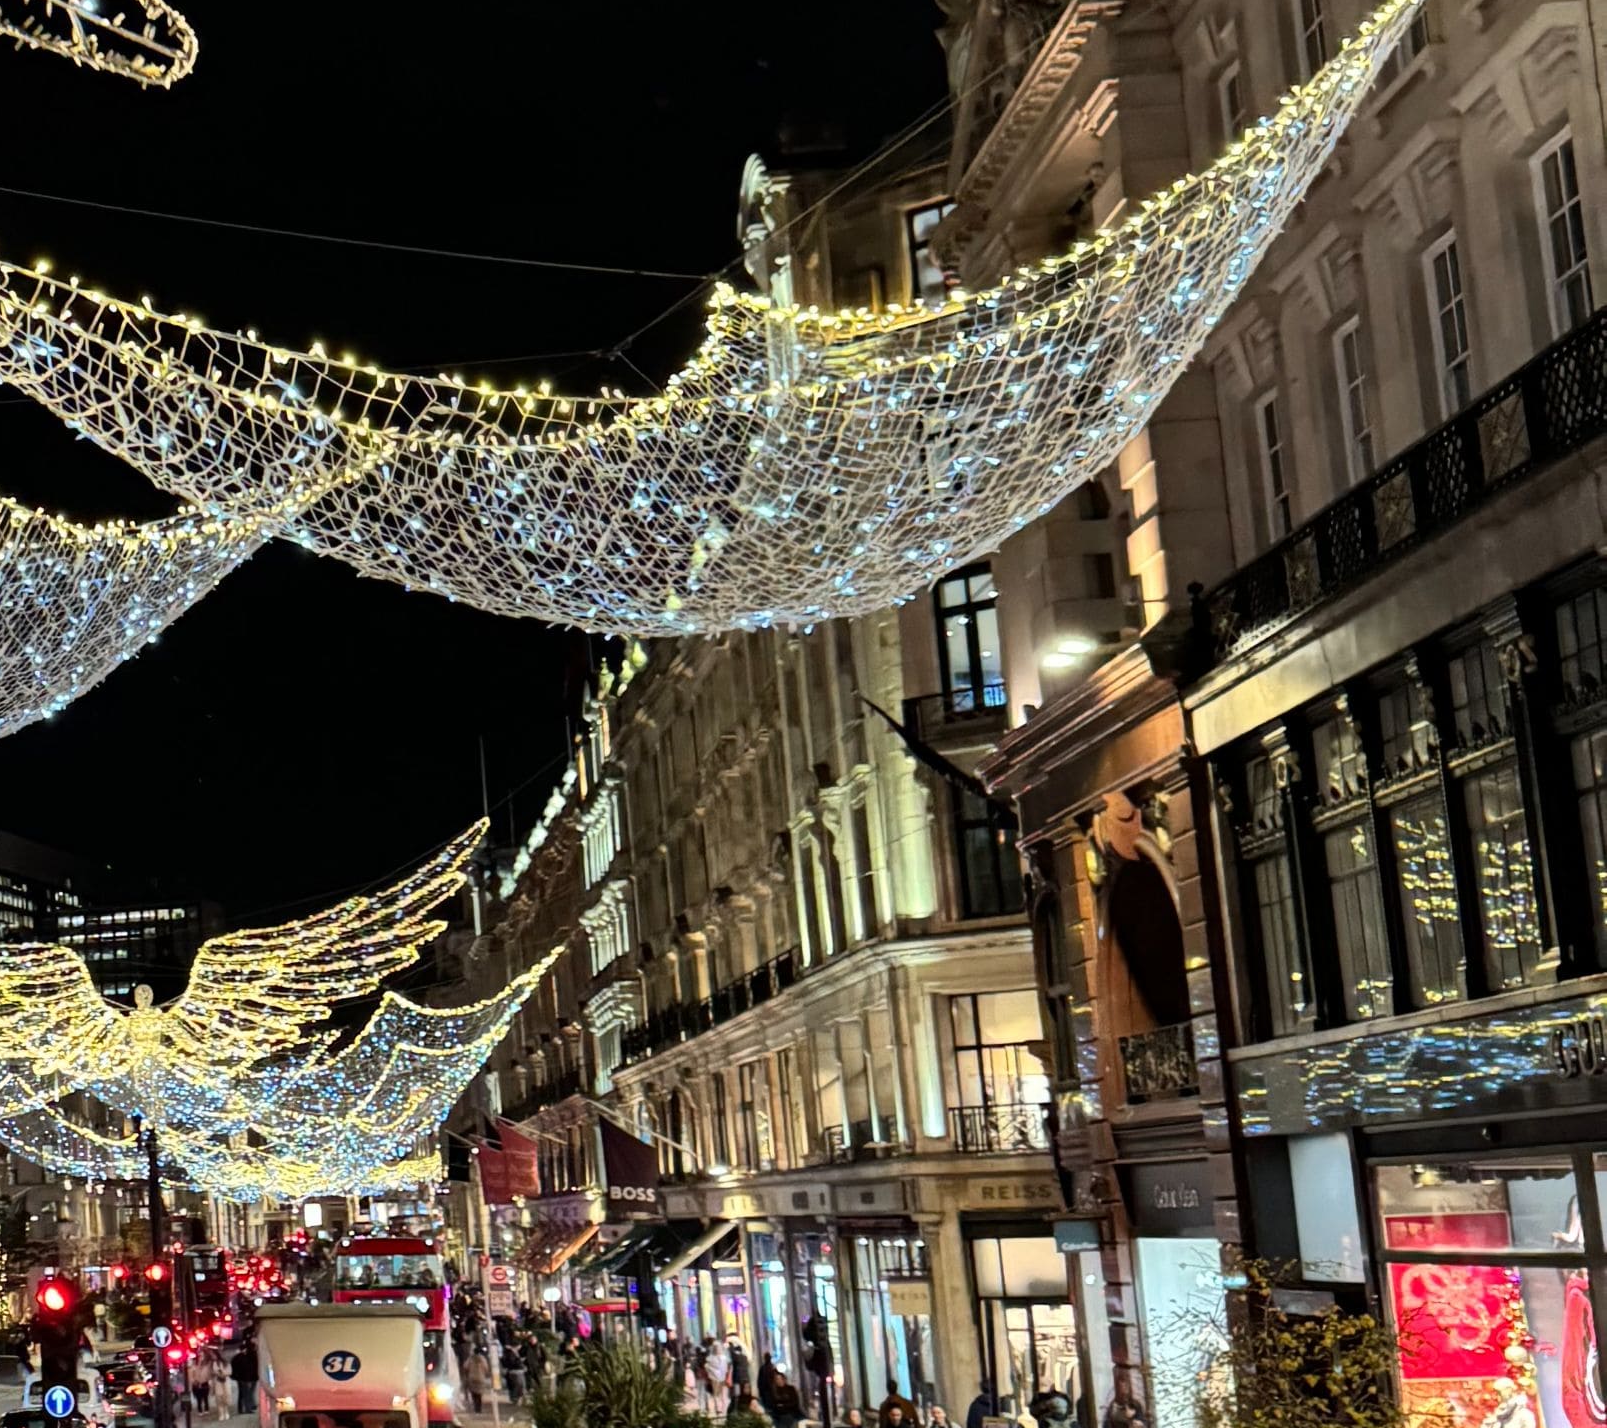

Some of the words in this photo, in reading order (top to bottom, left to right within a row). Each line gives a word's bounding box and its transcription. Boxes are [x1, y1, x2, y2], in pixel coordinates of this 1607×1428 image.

[609, 1185, 656, 1203] BOSS
[981, 1184, 1052, 1200] REISS
[325, 1356, 357, 1373] 3L
